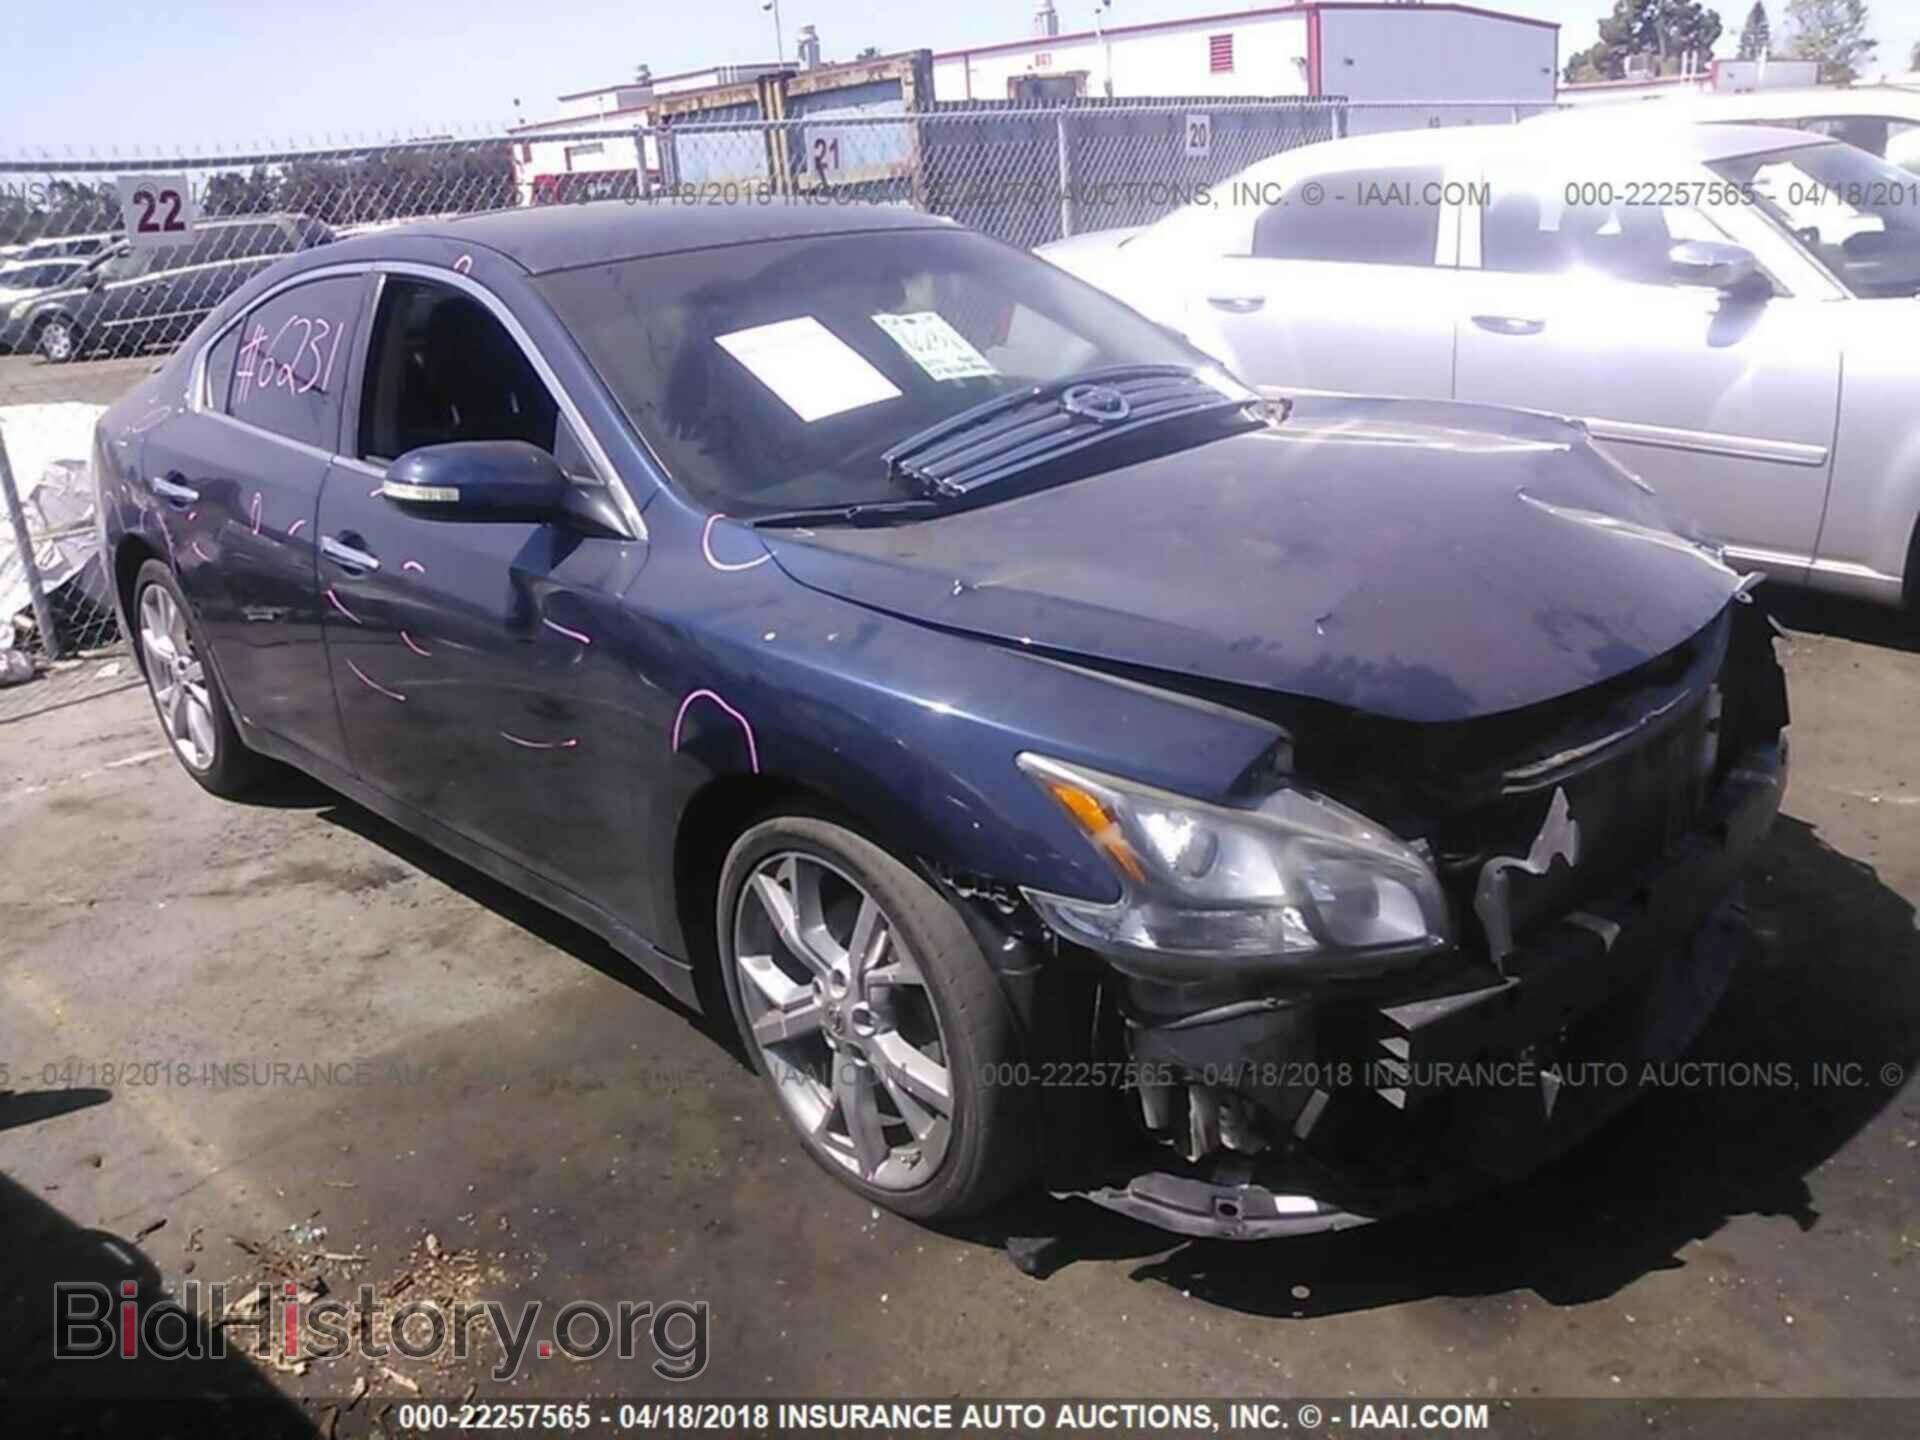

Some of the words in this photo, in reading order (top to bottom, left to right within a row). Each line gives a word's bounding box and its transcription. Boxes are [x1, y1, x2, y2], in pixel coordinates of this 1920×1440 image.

[813, 138, 840, 170] 21
[1189, 123, 1207, 148] 20
[132, 190, 186, 233] 22
[236, 314, 345, 404] #6231
